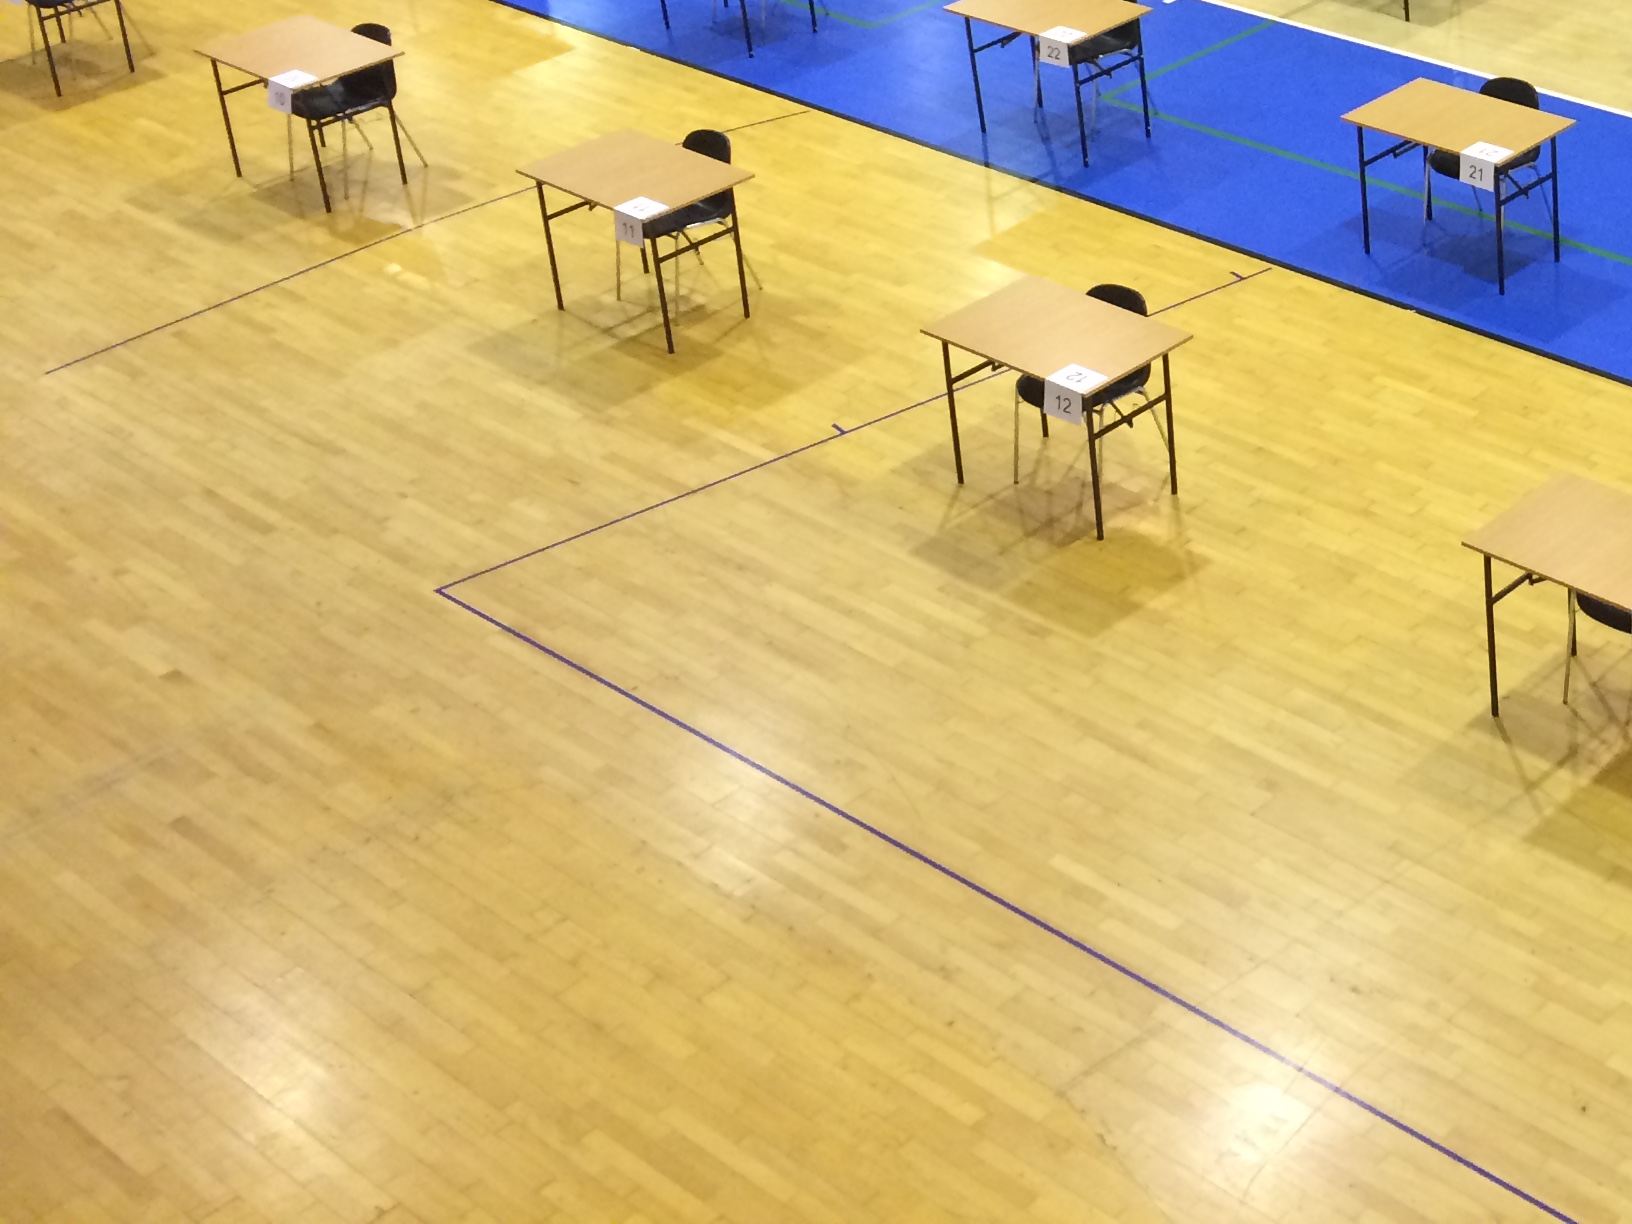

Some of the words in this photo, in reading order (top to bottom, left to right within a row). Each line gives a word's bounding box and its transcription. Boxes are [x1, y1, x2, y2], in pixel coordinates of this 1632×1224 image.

[1048, 46, 1060, 60] 22
[275, 92, 286, 106] 10
[1479, 148, 1498, 156] 21
[1469, 165, 1482, 181] 21
[623, 222, 634, 238] 11
[1066, 372, 1087, 382] 12
[1056, 395, 1071, 414] 12
